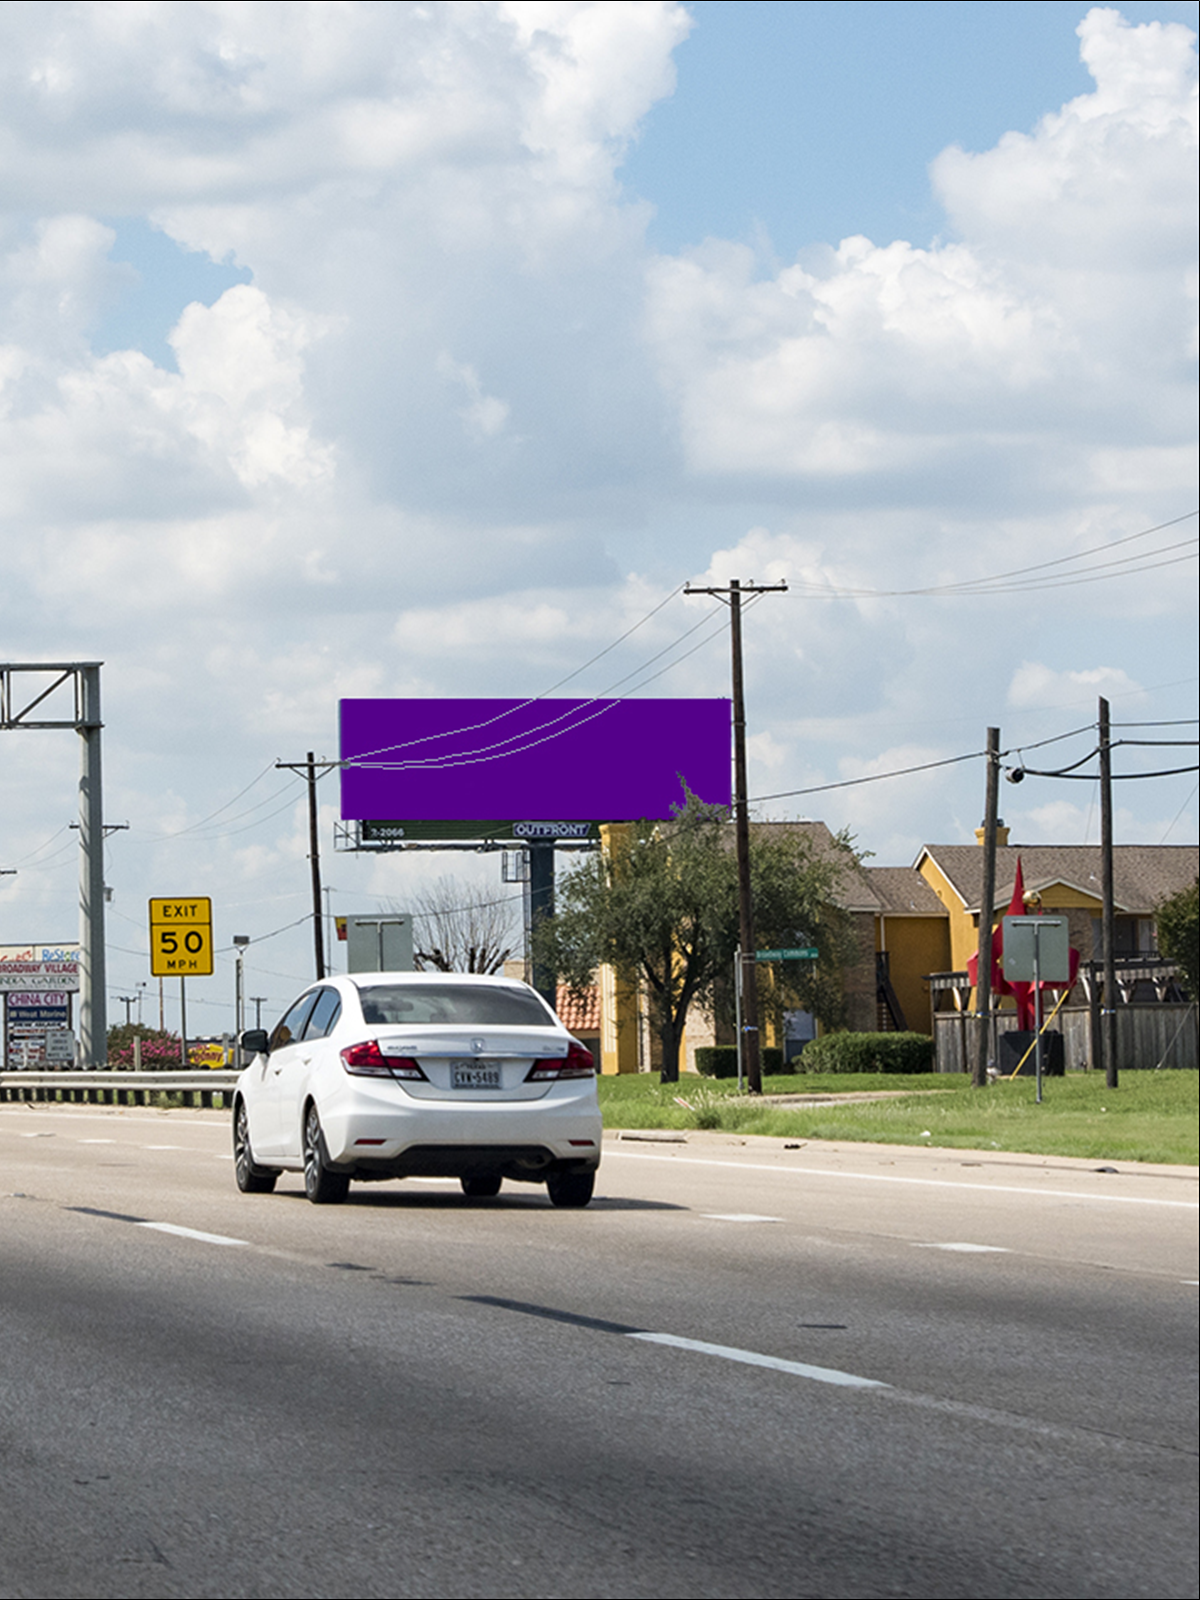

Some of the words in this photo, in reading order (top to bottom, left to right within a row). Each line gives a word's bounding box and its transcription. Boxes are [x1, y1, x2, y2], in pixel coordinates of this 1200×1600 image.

[516, 823, 588, 836] OUTFRONT
[163, 904, 198, 918] EXIT
[161, 930, 203, 954] 50
[44, 963, 78, 974] VILLAGE
[167, 959, 198, 969] MPH
[8, 992, 42, 1006] CHINA
[44, 992, 66, 1006] CITY
